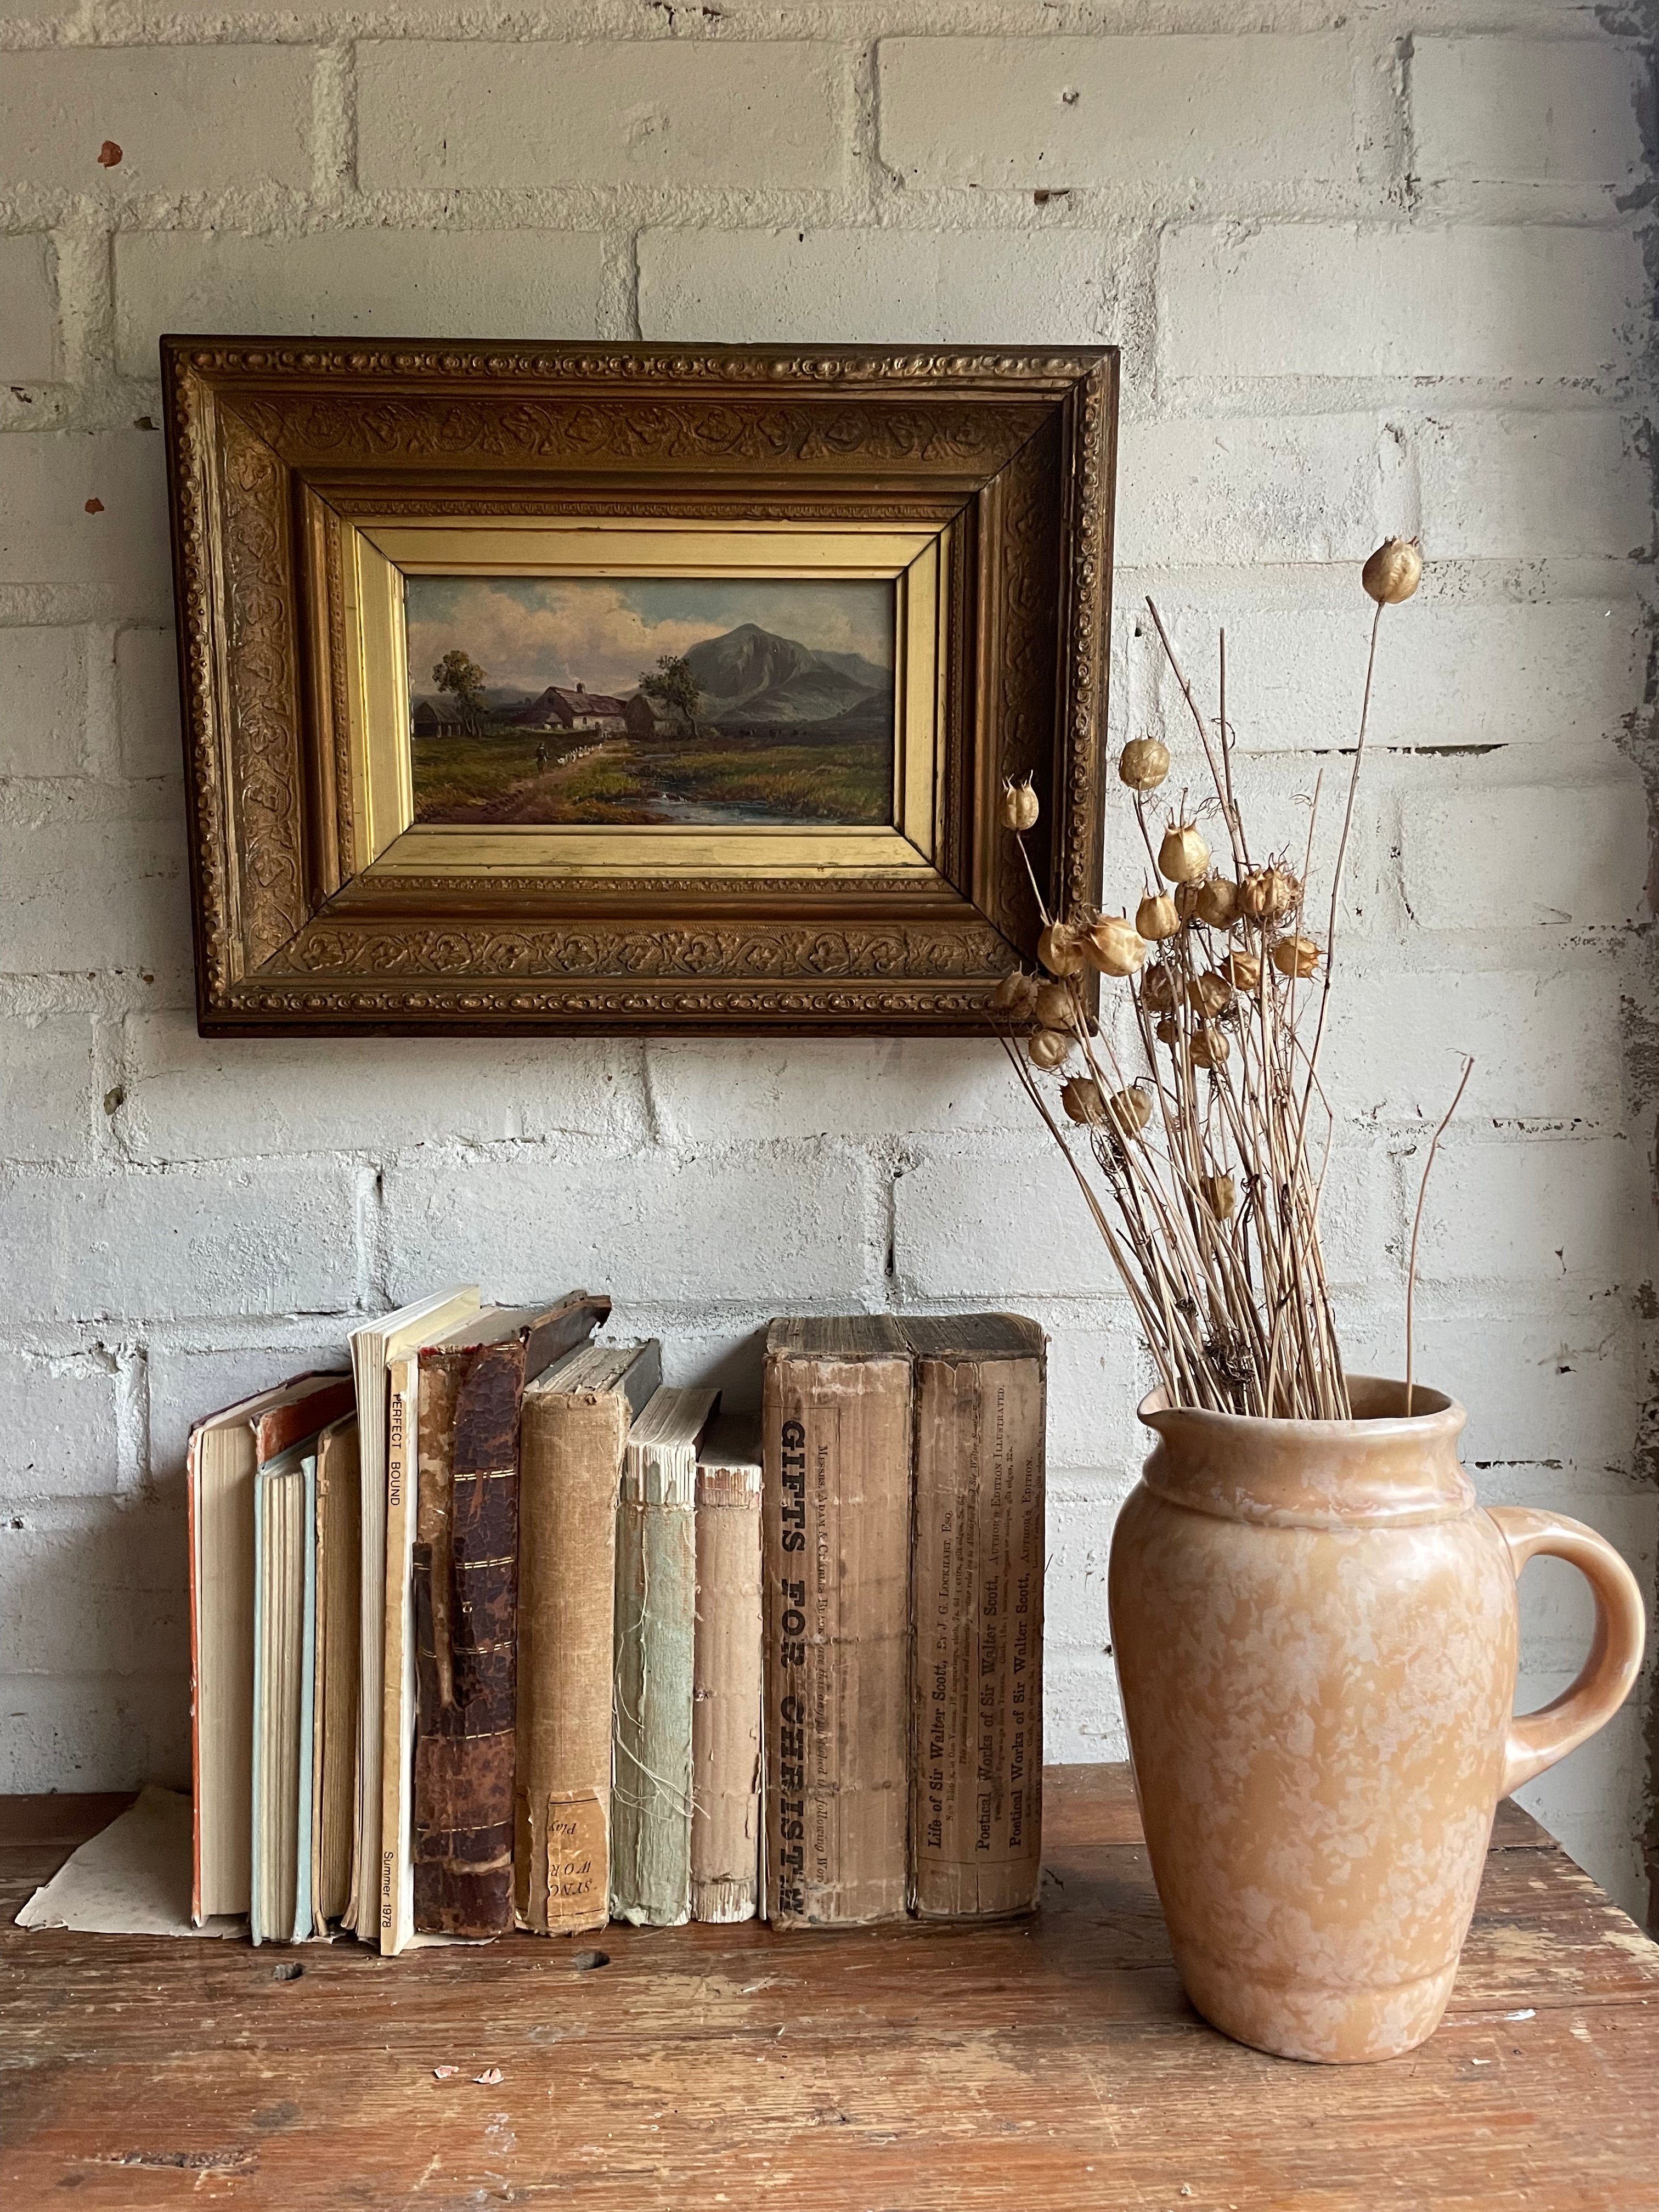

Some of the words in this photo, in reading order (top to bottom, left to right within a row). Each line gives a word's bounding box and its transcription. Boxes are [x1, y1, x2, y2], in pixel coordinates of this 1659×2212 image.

[391, 1393, 403, 1449] PERFECT
[390, 1462, 402, 1506] BOUND
[781, 1420, 806, 1553] GIFTS
[938, 1603, 949, 1615] G.
[983, 1575, 999, 1616] Scott,
[1016, 1573, 1031, 1613] Scott,
[781, 1579, 806, 1668] FOR
[981, 1624, 997, 1676] Walter
[1014, 1621, 1028, 1675] Walter
[932, 1660, 948, 1701] Scott,
[980, 1684, 995, 1707] Sir
[1013, 1681, 1025, 1704] Sir
[930, 1708, 945, 1759] Walter
[980, 1711, 994, 1727] of
[1012, 1710, 1024, 1725] of
[978, 1735, 993, 1782] Works
[1011, 1732, 1024, 1782] Works
[929, 1769, 943, 1791] Sir
[929, 1795, 943, 1812] of
[975, 1792, 992, 1852] Poetical
[1009, 1790, 1023, 1848] Poetical
[549, 1820, 577, 1836] Play
[814, 1797, 828, 1853] following
[927, 1819, 942, 1849] Life
[382, 1851, 394, 1897] Summer
[551, 1860, 591, 1877] WOR
[816, 1858, 828, 1885] Wor
[382, 1903, 392, 1928] 1978
